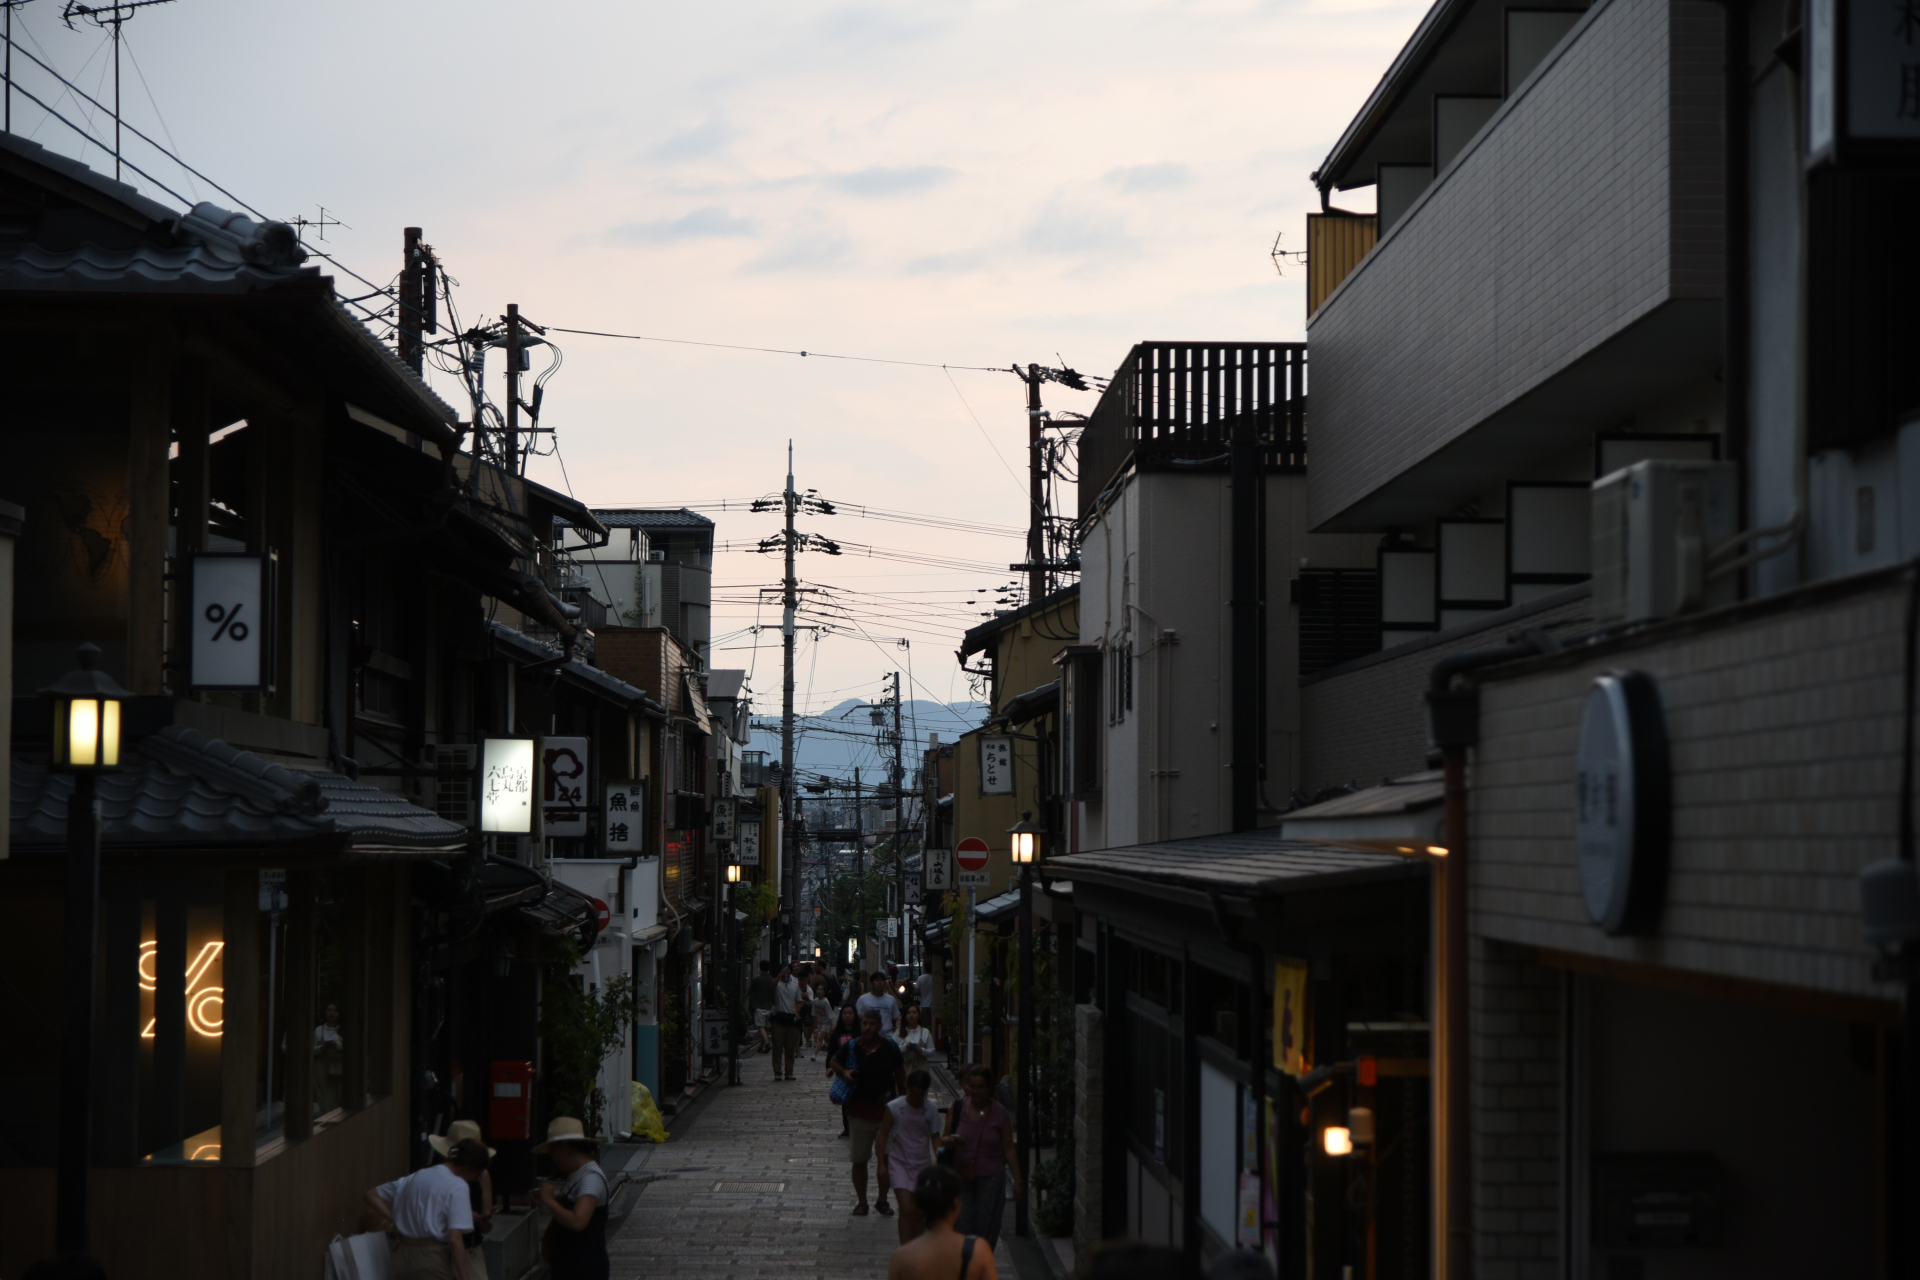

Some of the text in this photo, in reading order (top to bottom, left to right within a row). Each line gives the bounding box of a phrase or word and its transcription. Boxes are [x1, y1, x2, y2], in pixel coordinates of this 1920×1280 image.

[205, 603, 249, 641] %
[986, 752, 997, 785] ちとせ
[999, 744, 1007, 766] 旅館
[486, 765, 501, 805] 六七堂
[516, 766, 528, 793] 京都
[629, 786, 640, 812] 鮮魚
[609, 792, 629, 842] 魚捨
[715, 804, 727, 836] 魚藤
[960, 874, 989, 883] 自転車を除く
